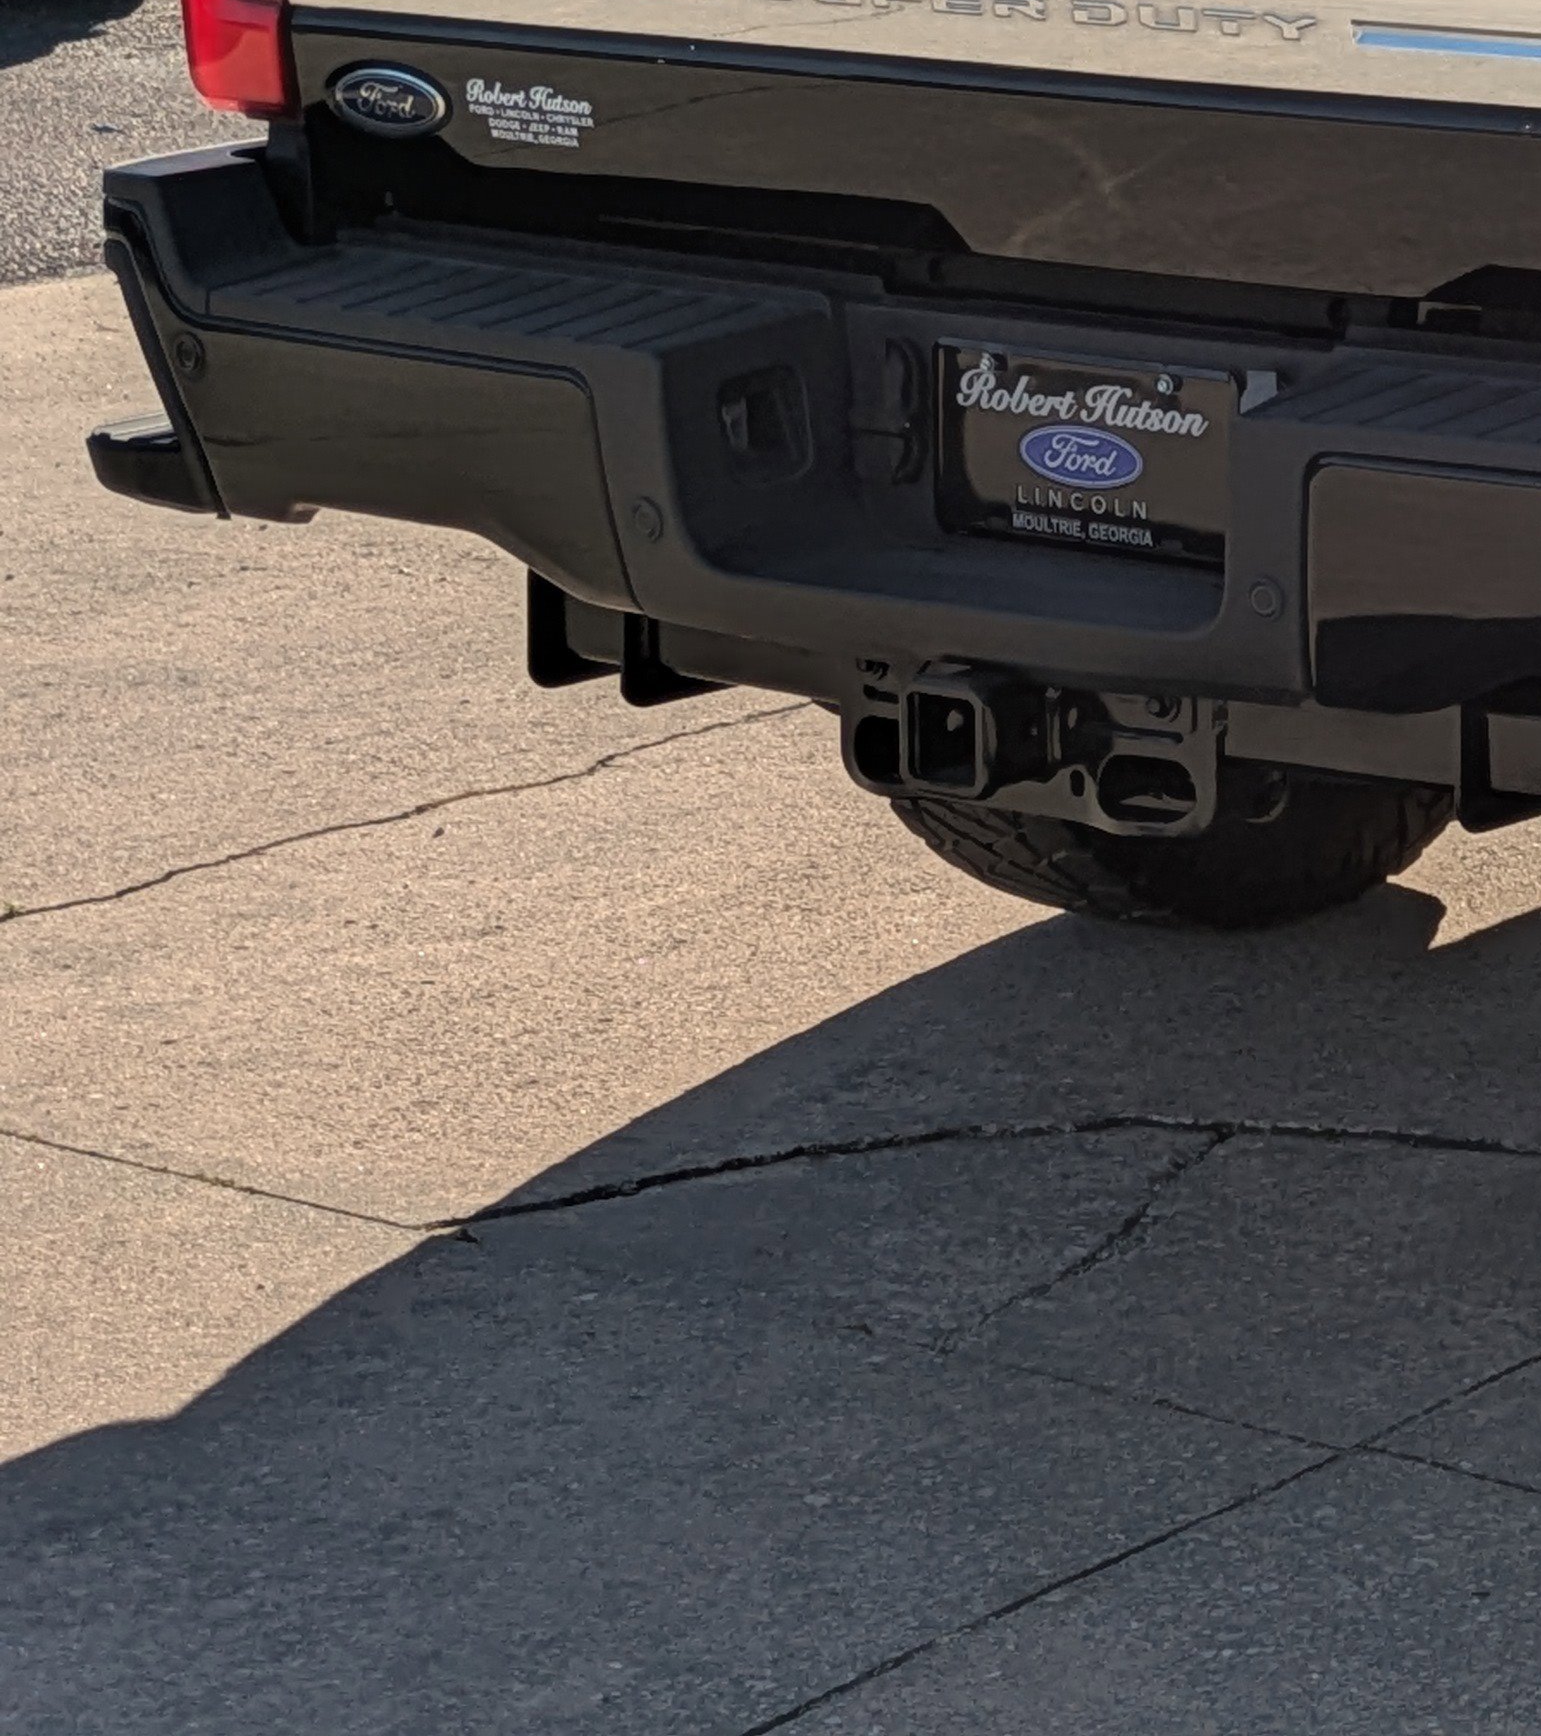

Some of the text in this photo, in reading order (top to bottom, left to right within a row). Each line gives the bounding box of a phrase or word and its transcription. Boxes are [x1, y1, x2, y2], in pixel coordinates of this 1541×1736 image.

[356, 81, 417, 119] Ford
[465, 77, 593, 115] Robert Hutson
[468, 103, 595, 129] FORD LINCOLN CHRYSLER
[488, 117, 580, 138] DODGE JEEP RAM
[538, 133, 580, 149] GEORGIA
[955, 367, 1210, 438] Robert Hutson
[1043, 432, 1118, 477] Ford
[1016, 484, 1148, 520] LINCOLN
[1011, 512, 1155, 547] MOULTRIE, GEORGIA
